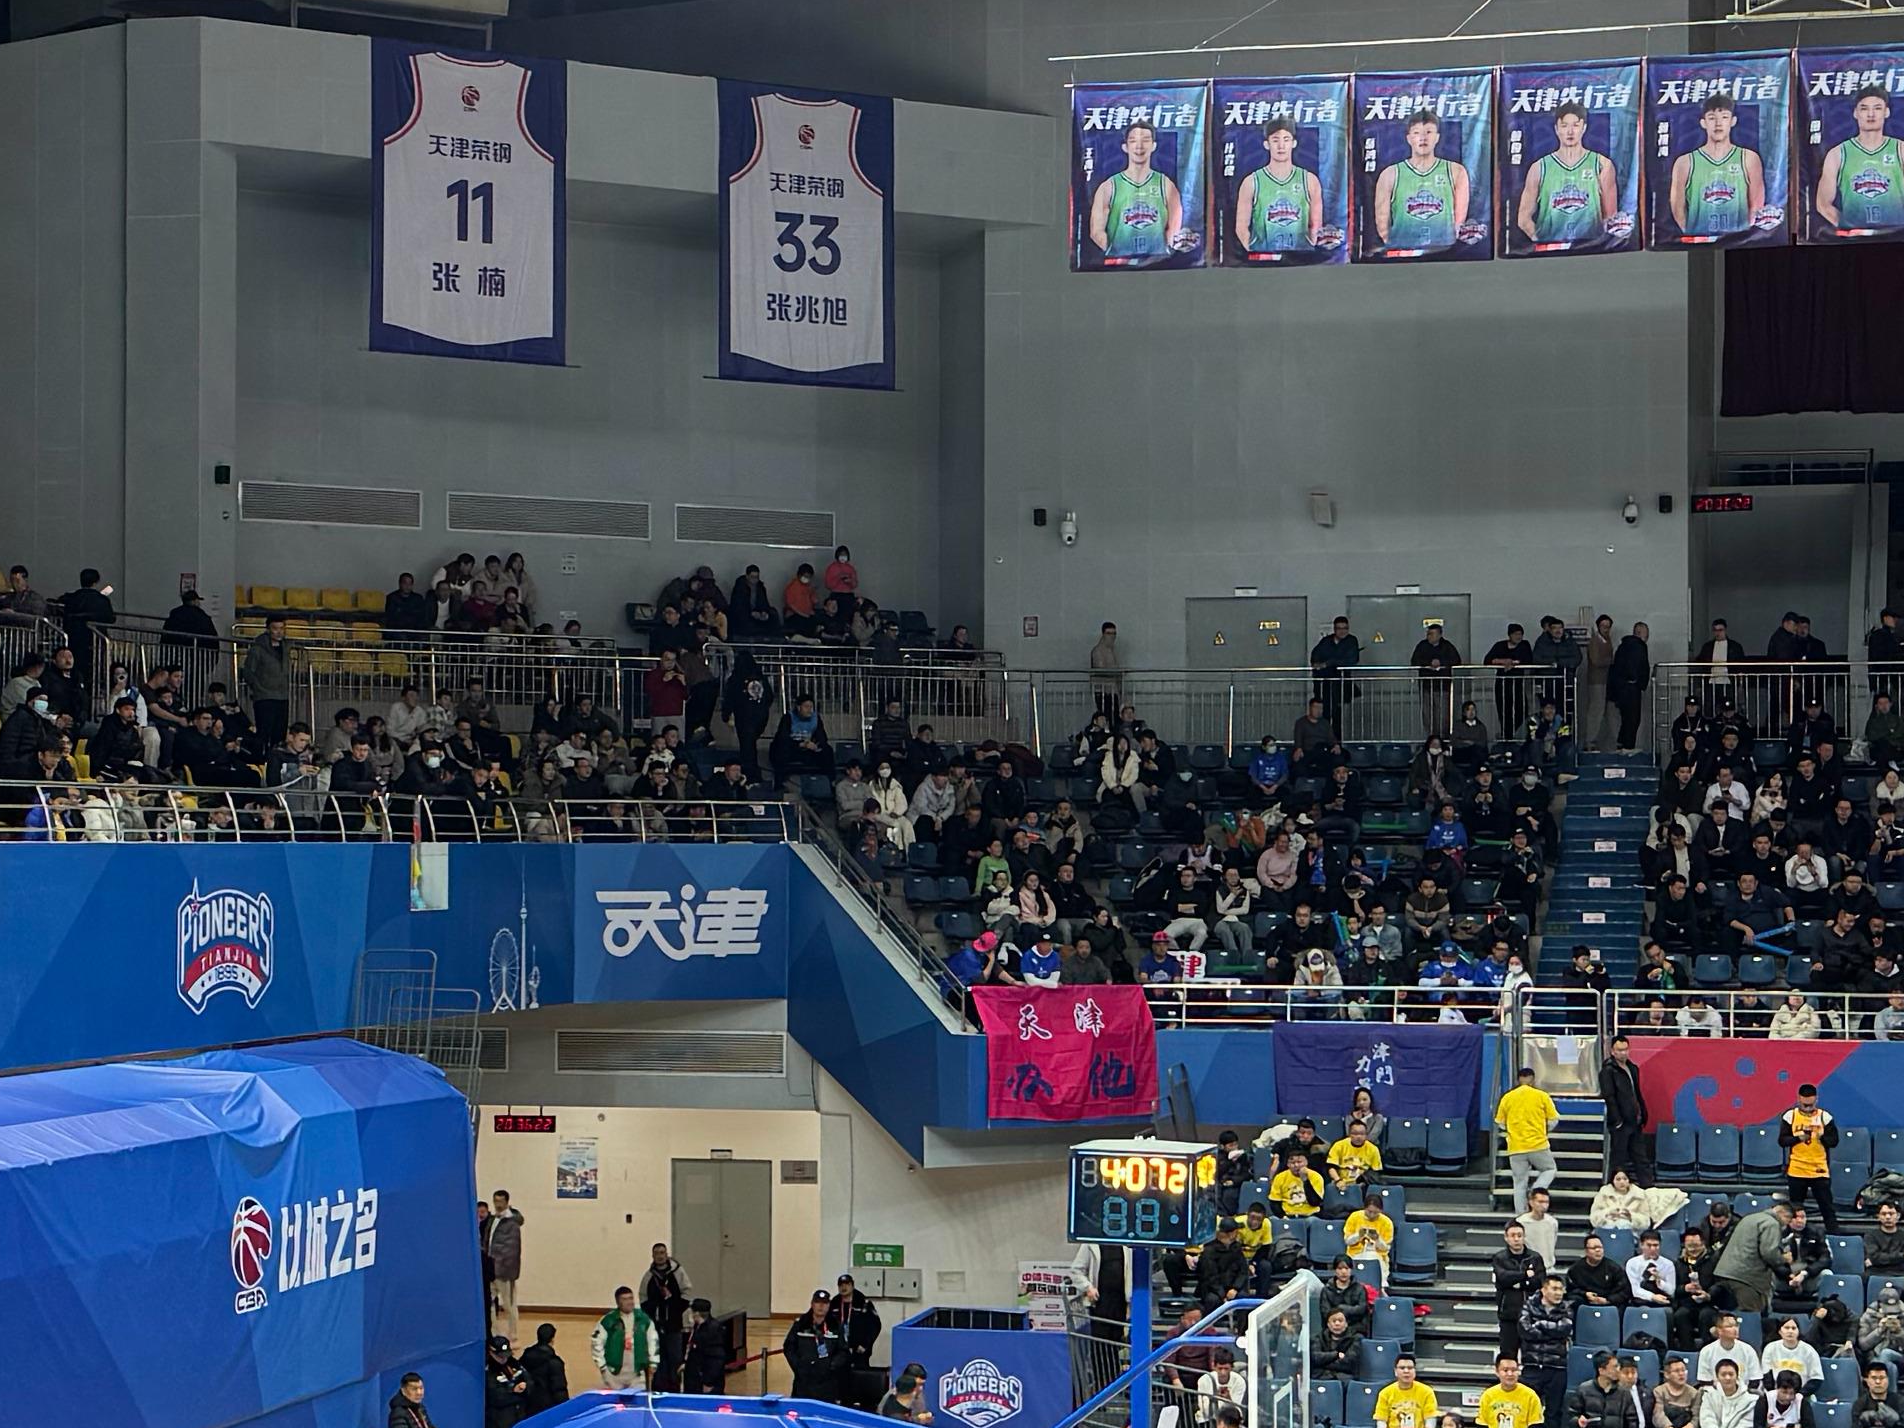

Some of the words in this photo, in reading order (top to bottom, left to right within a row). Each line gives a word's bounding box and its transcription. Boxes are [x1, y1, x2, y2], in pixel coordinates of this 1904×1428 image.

[428, 133, 512, 164] 天津荣钢
[769, 170, 845, 199] 天津荣钢
[446, 179, 494, 244] 11
[772, 211, 842, 276] 33
[766, 293, 849, 327] 张兆旭
[182, 894, 272, 977] PIONEERS
[596, 885, 770, 959] 天津
[200, 946, 253, 971] TIANJIN
[1019, 998, 1105, 1040] 天津
[278, 1186, 379, 1293] 以城之名
[233, 1286, 269, 1315] CBA
[944, 1376, 1019, 1408] PIONEERS
